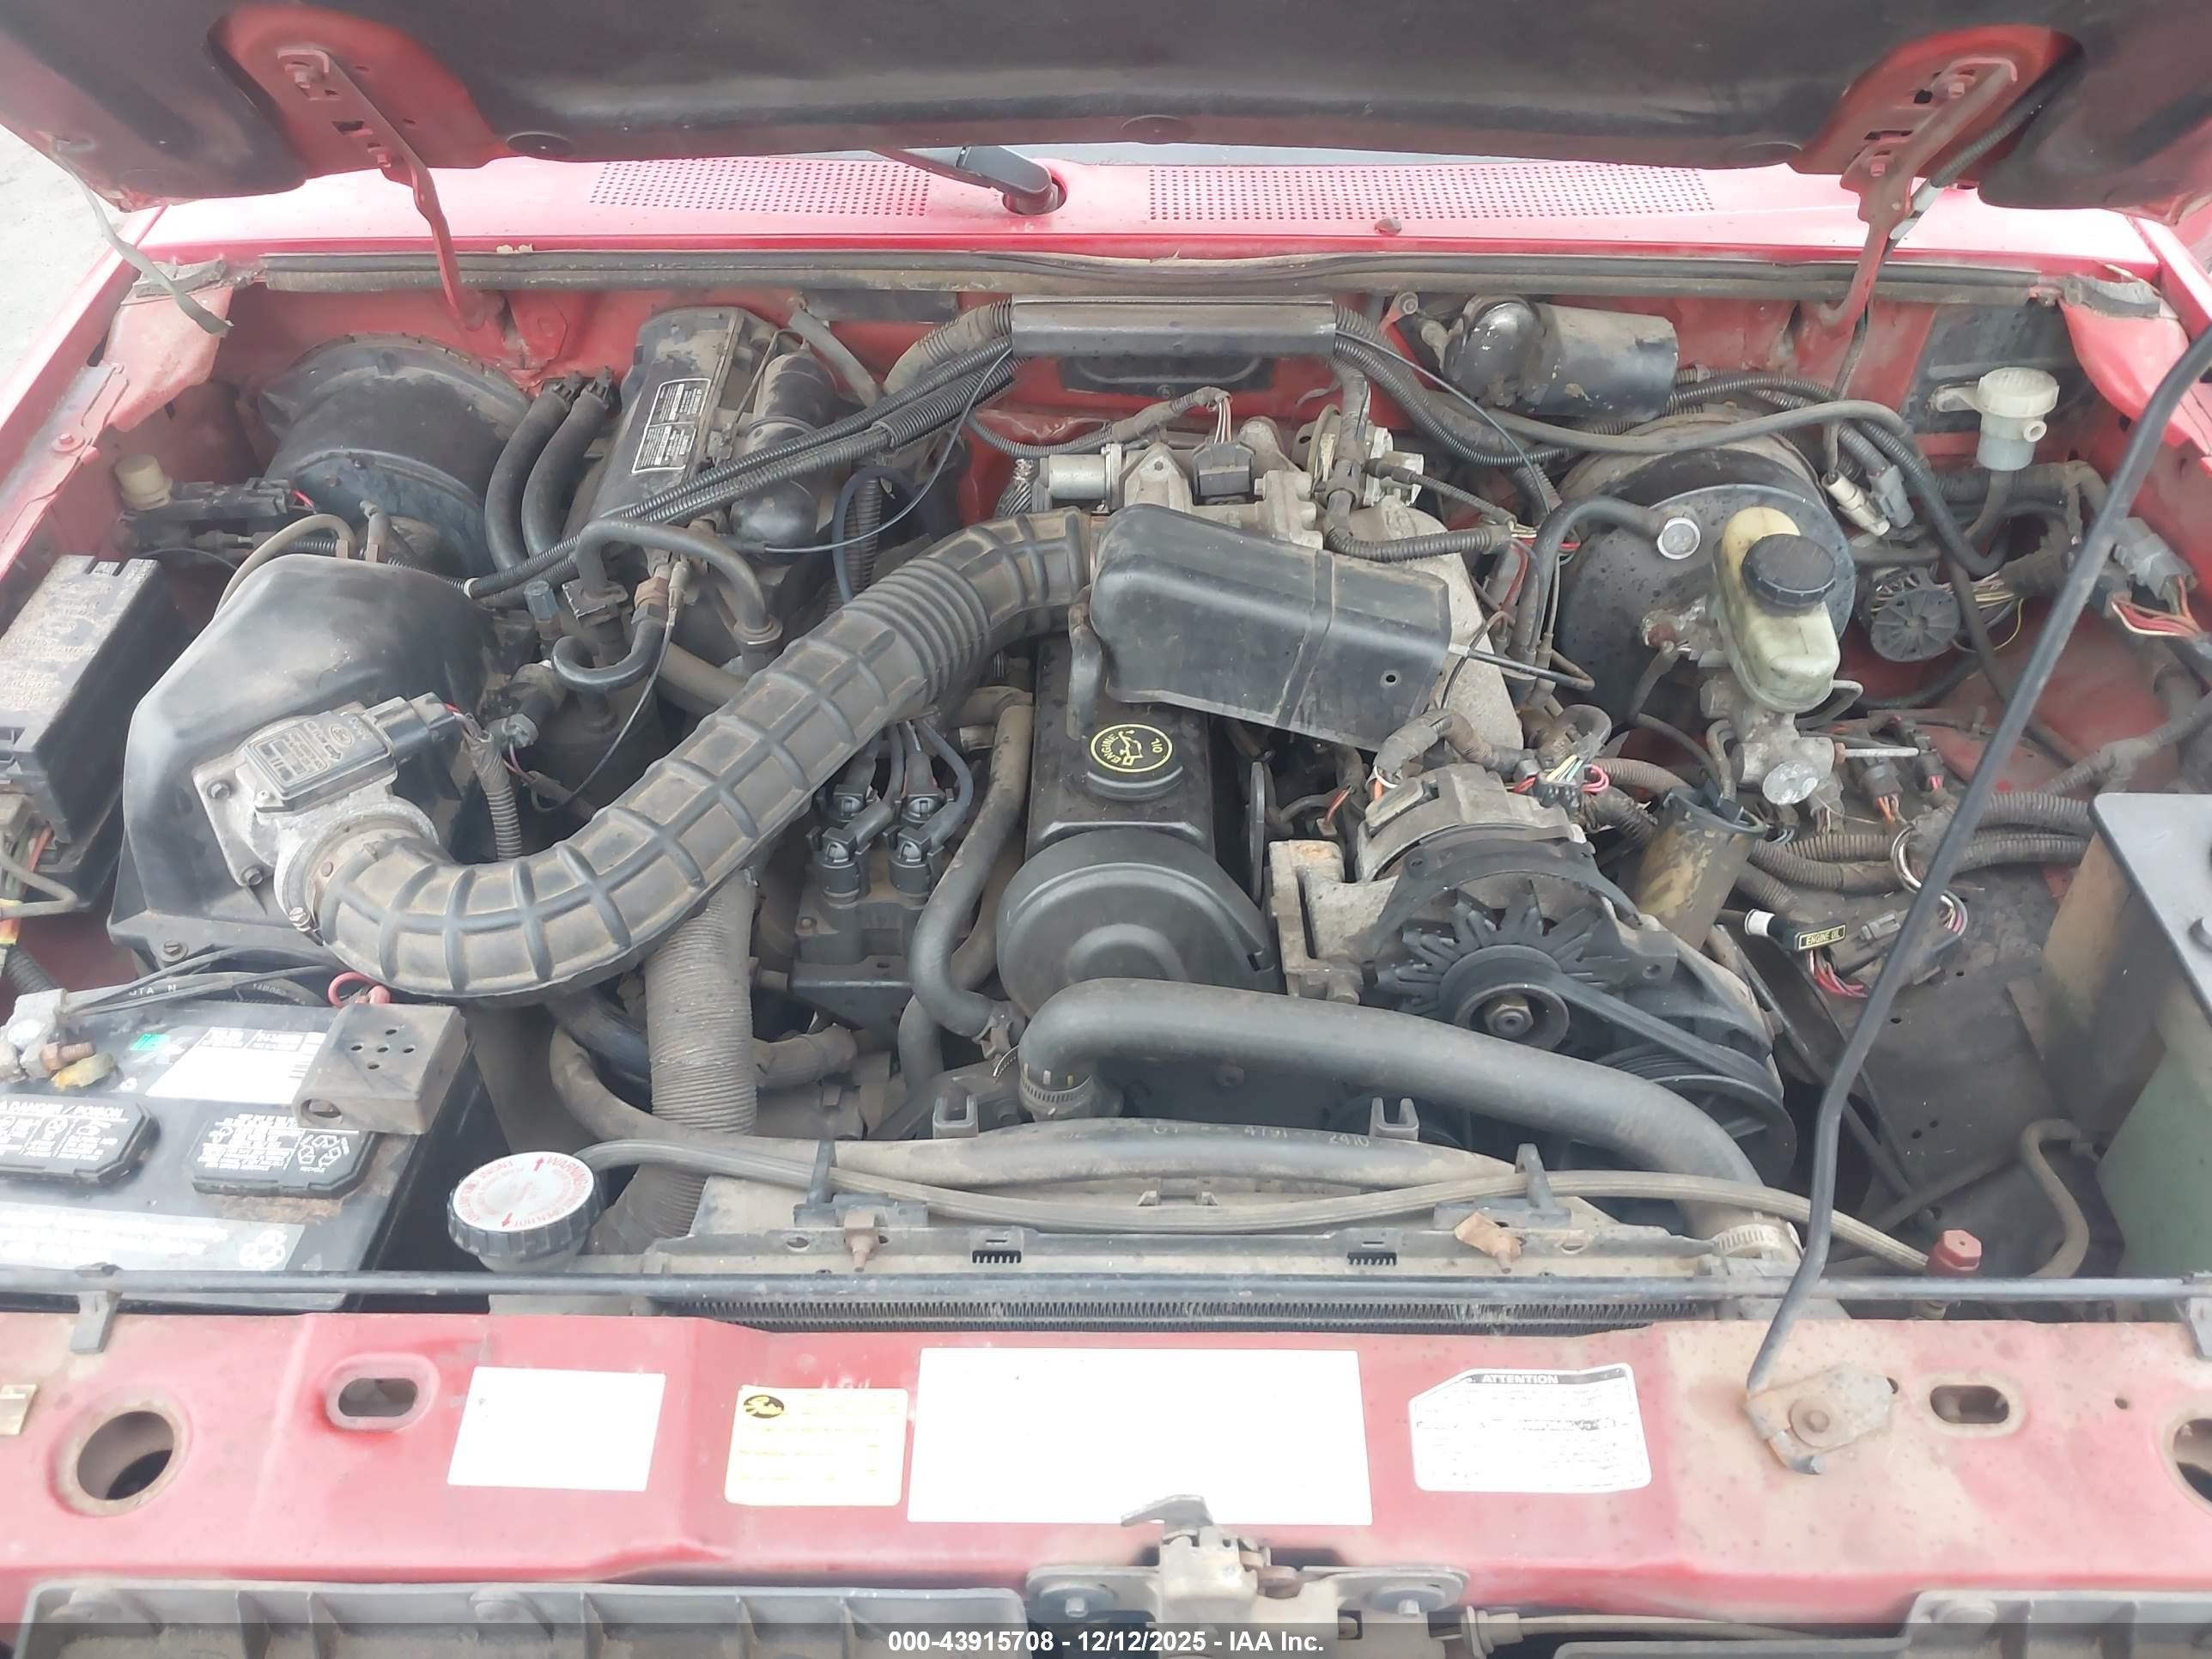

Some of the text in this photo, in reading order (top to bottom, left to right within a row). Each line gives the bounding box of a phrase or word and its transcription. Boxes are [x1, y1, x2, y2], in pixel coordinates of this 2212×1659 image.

[1101, 734, 1164, 763] ENGINE OIL
[1806, 928, 1840, 945] ENGINE OIL
[8, 1101, 63, 1115] DANGER
[73, 1105, 125, 1118] POISON
[1482, 1374, 1559, 1384] ATTENTION
